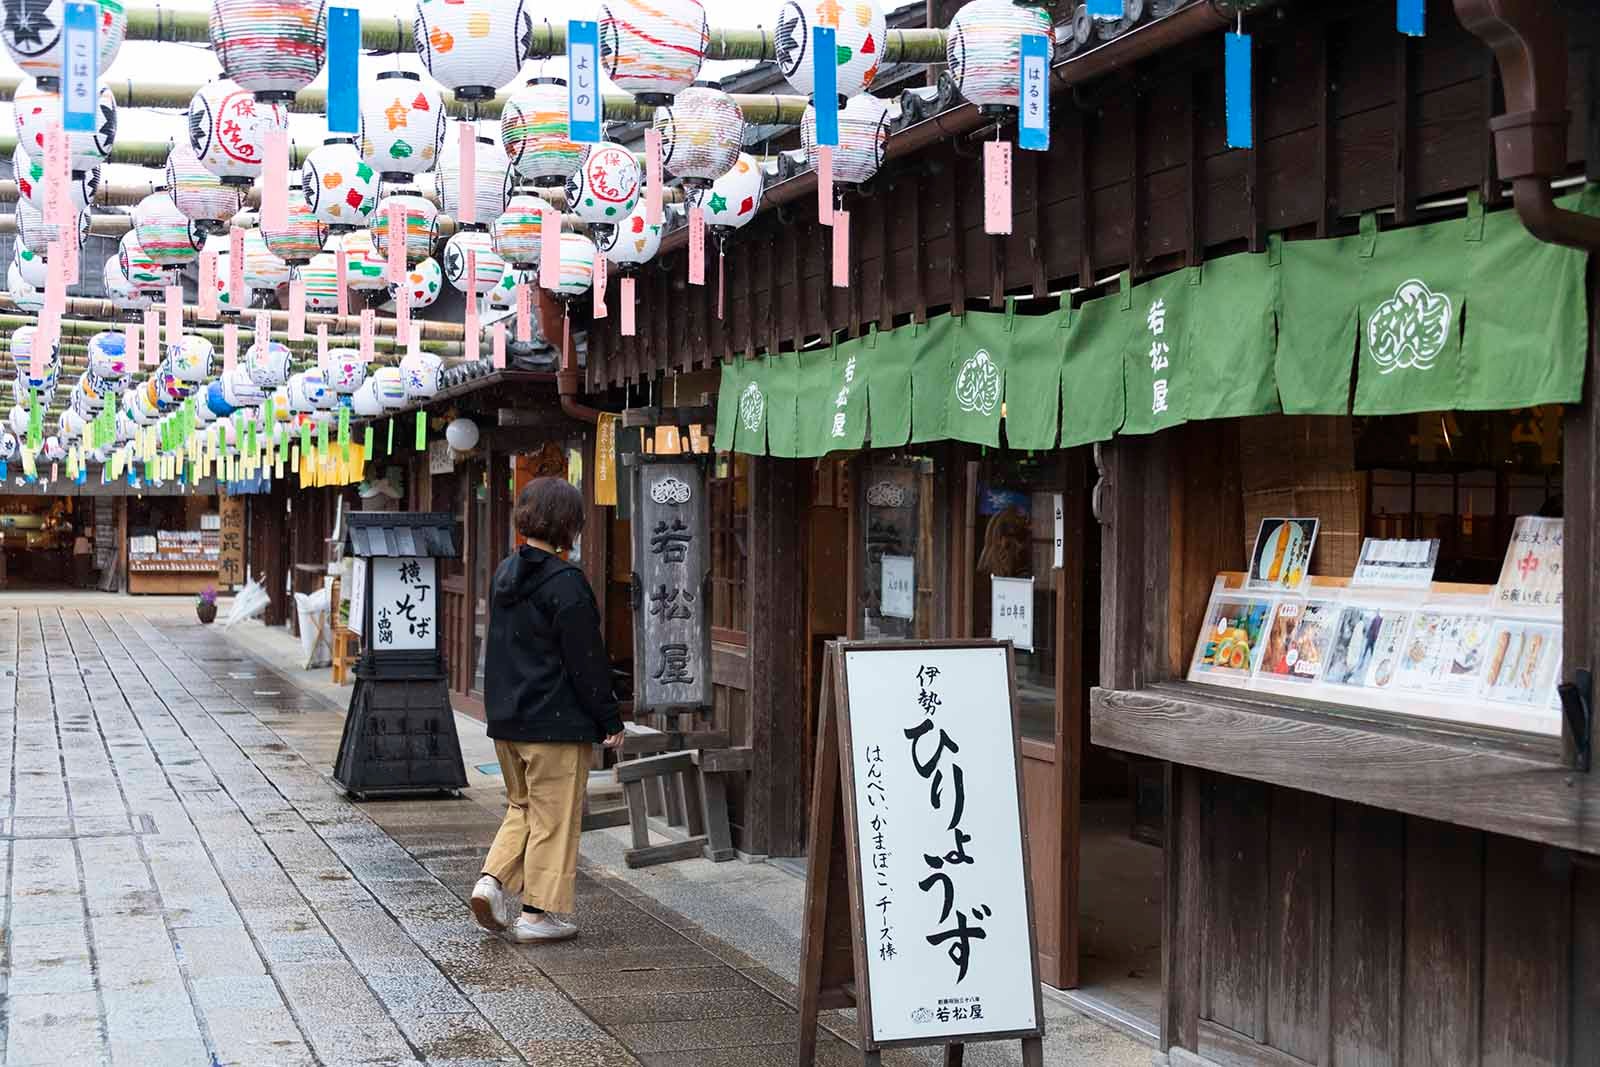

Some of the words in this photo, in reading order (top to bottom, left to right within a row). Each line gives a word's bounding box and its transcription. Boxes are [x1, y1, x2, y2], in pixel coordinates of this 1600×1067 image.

[576, 55, 590, 107] よしの
[1028, 67, 1041, 116] はるき
[1147, 298, 1169, 414] 若松屋
[830, 355, 857, 438] 若松屋
[377, 606, 393, 645] 小西湖
[395, 560, 432, 639] 横丁そば
[649, 519, 694, 686] 若松屋
[916, 664, 942, 716] 伊勢
[903, 718, 992, 985] ひりょうず
[935, 1004, 985, 1023] 若松屋
